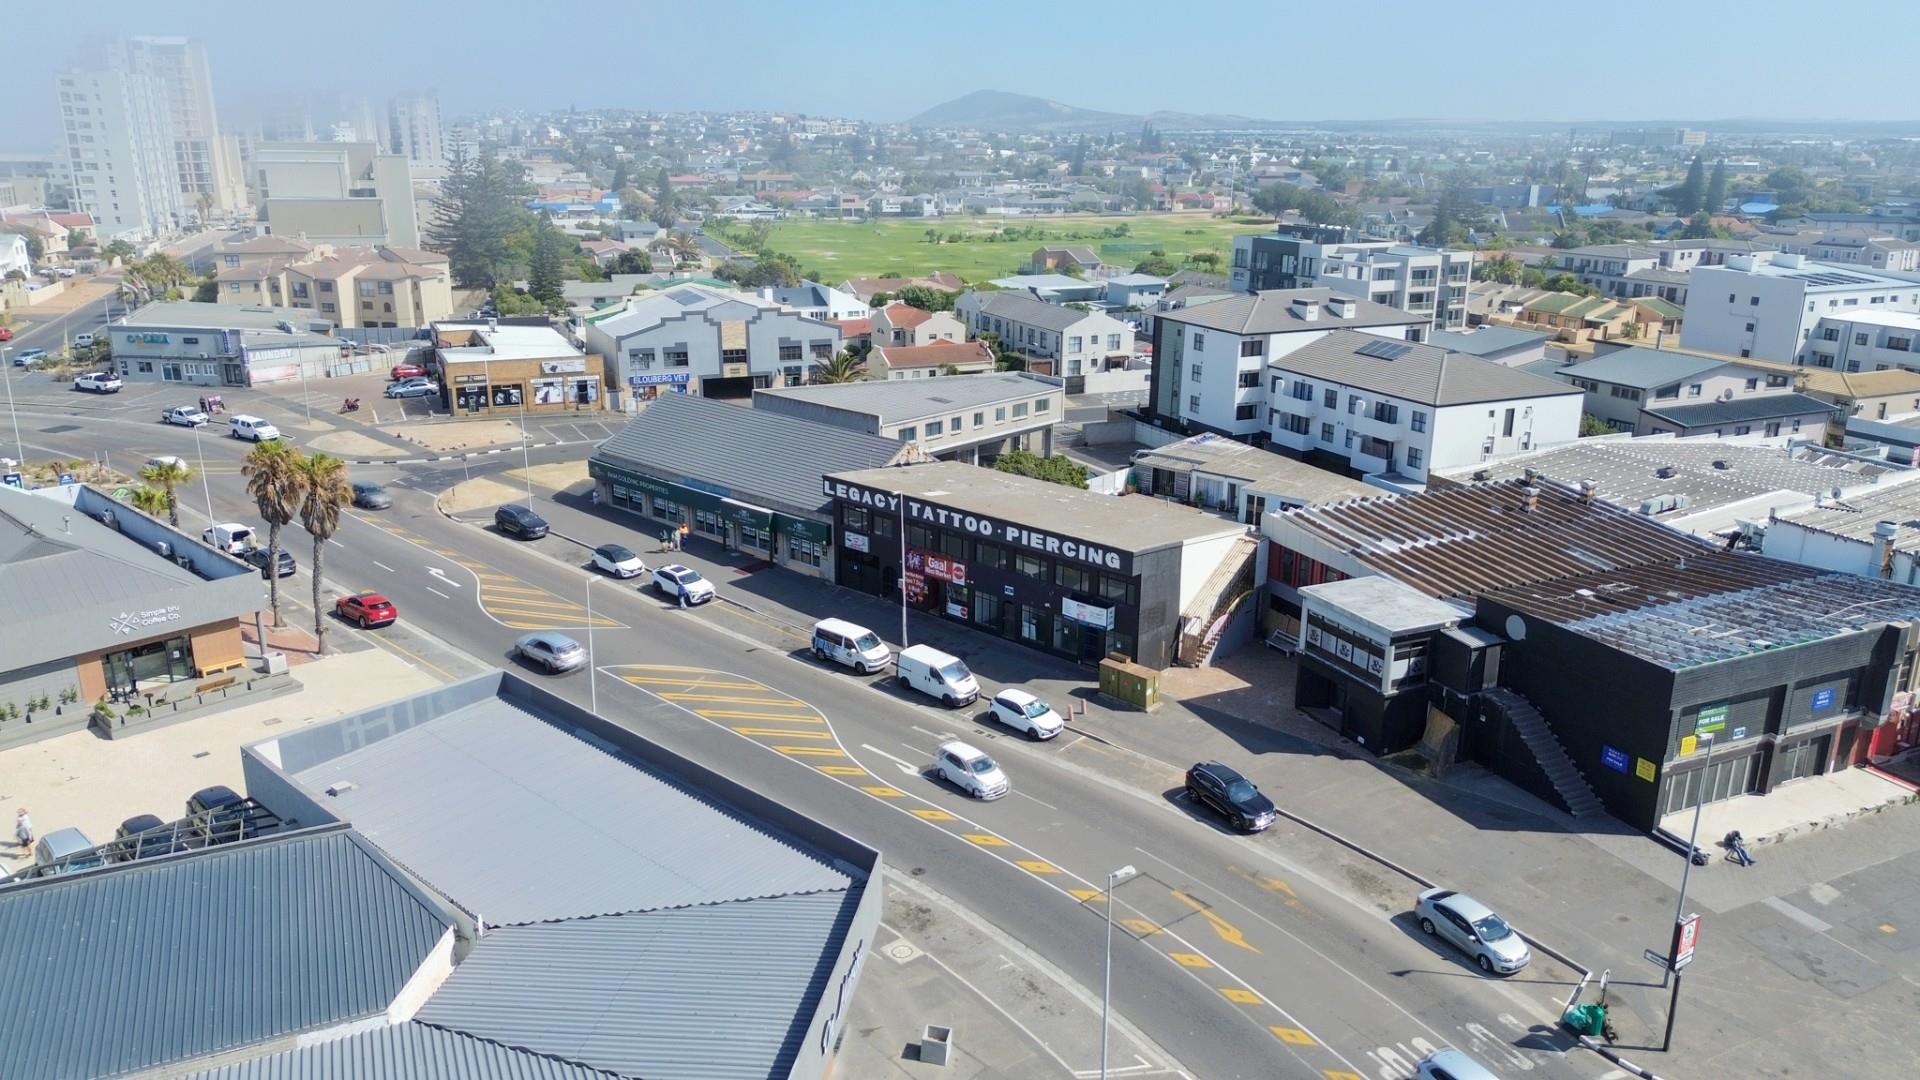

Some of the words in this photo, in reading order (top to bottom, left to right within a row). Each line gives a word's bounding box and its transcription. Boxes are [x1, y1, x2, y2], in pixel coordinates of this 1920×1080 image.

[249, 349, 292, 361] LAUNDRY
[674, 373, 687, 382] VET
[824, 480, 898, 511] LEGACY
[909, 501, 992, 536] TATTOO
[1006, 526, 1121, 570] PIERCING
[928, 556, 947, 572] Gaal
[1698, 717, 1710, 726] FOR
[1710, 714, 1725, 723] SALE
